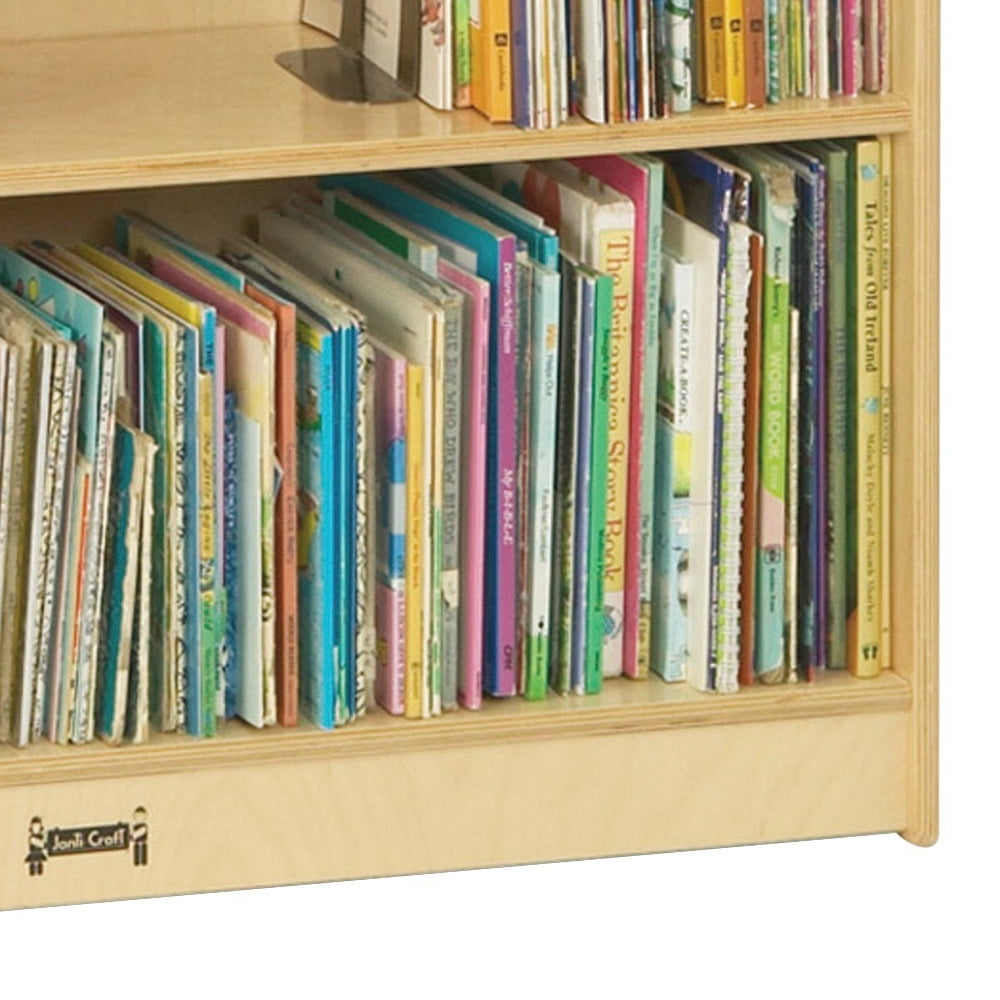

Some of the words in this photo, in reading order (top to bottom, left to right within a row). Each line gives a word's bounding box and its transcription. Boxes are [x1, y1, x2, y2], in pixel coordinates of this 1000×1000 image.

[864, 202, 878, 242] Tales
[606, 236, 630, 286] The
[862, 246, 878, 277] from
[865, 281, 878, 311] Old
[445, 318, 458, 353] THE
[865, 315, 878, 373] Ireland
[607, 294, 629, 432] Britannica
[768, 351, 783, 406] WORD
[445, 390, 457, 430] WHO
[768, 410, 782, 460] BOOK
[444, 436, 457, 485] DREW
[501, 468, 513, 488] My
[605, 439, 626, 512] Story
[443, 493, 456, 546] BIRDS
[604, 518, 623, 582] Book
[87, 828, 126, 847] Craft
